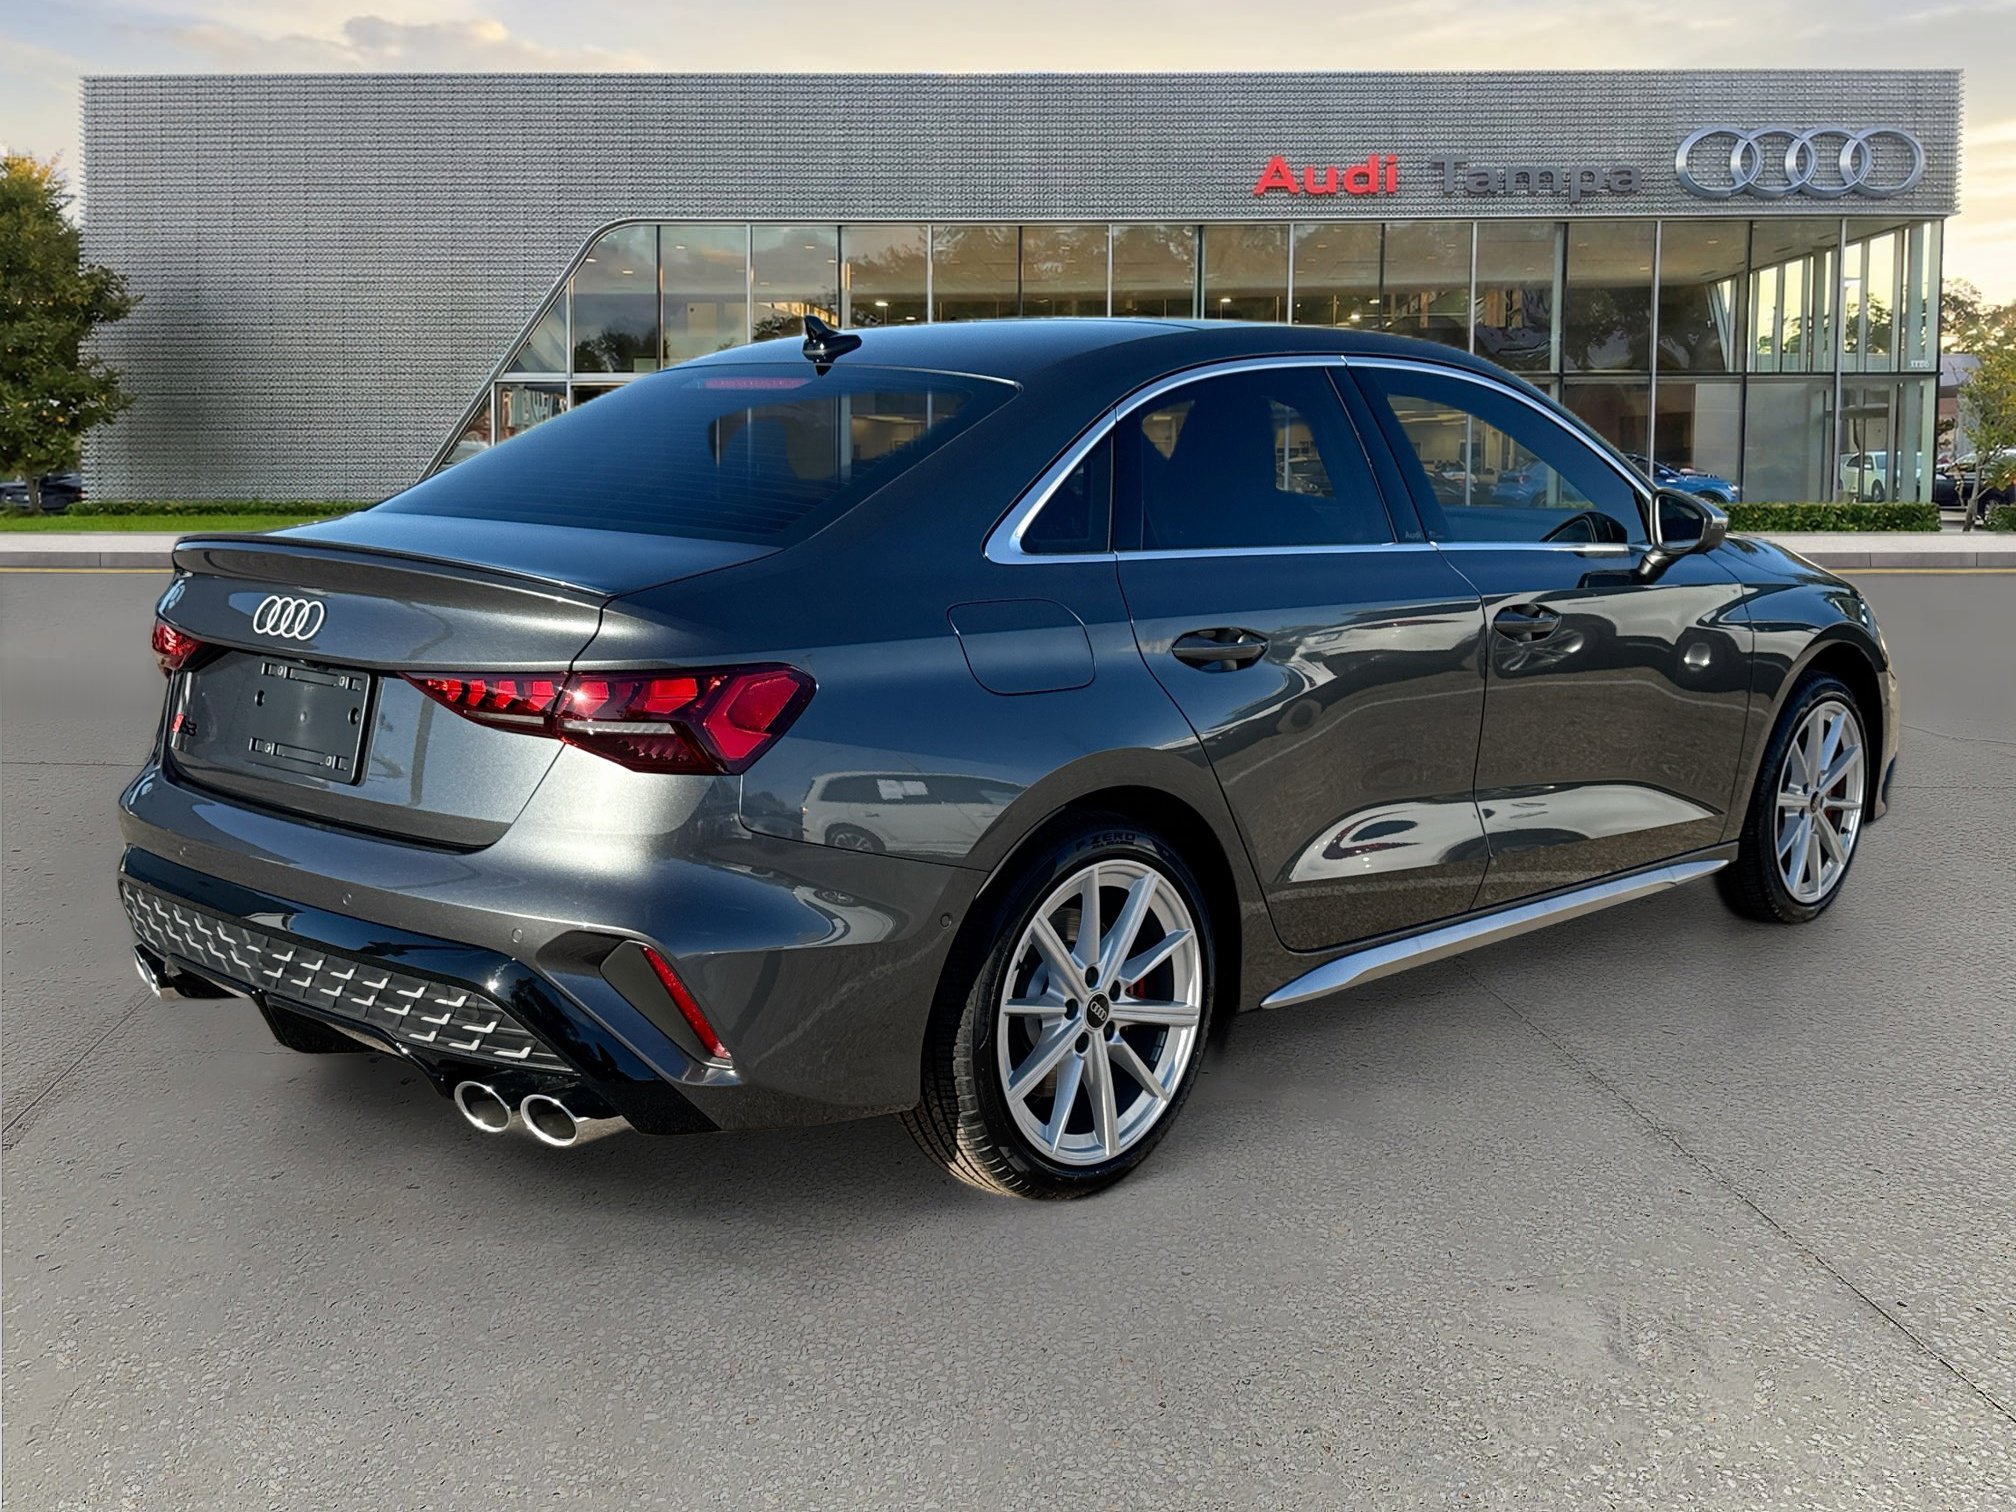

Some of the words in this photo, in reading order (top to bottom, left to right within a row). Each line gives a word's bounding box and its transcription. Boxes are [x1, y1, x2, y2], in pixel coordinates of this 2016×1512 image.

[1253, 154, 1398, 196] Audi
[1430, 154, 1642, 201] Tampa
[1090, 832, 1136, 845] ZERO
